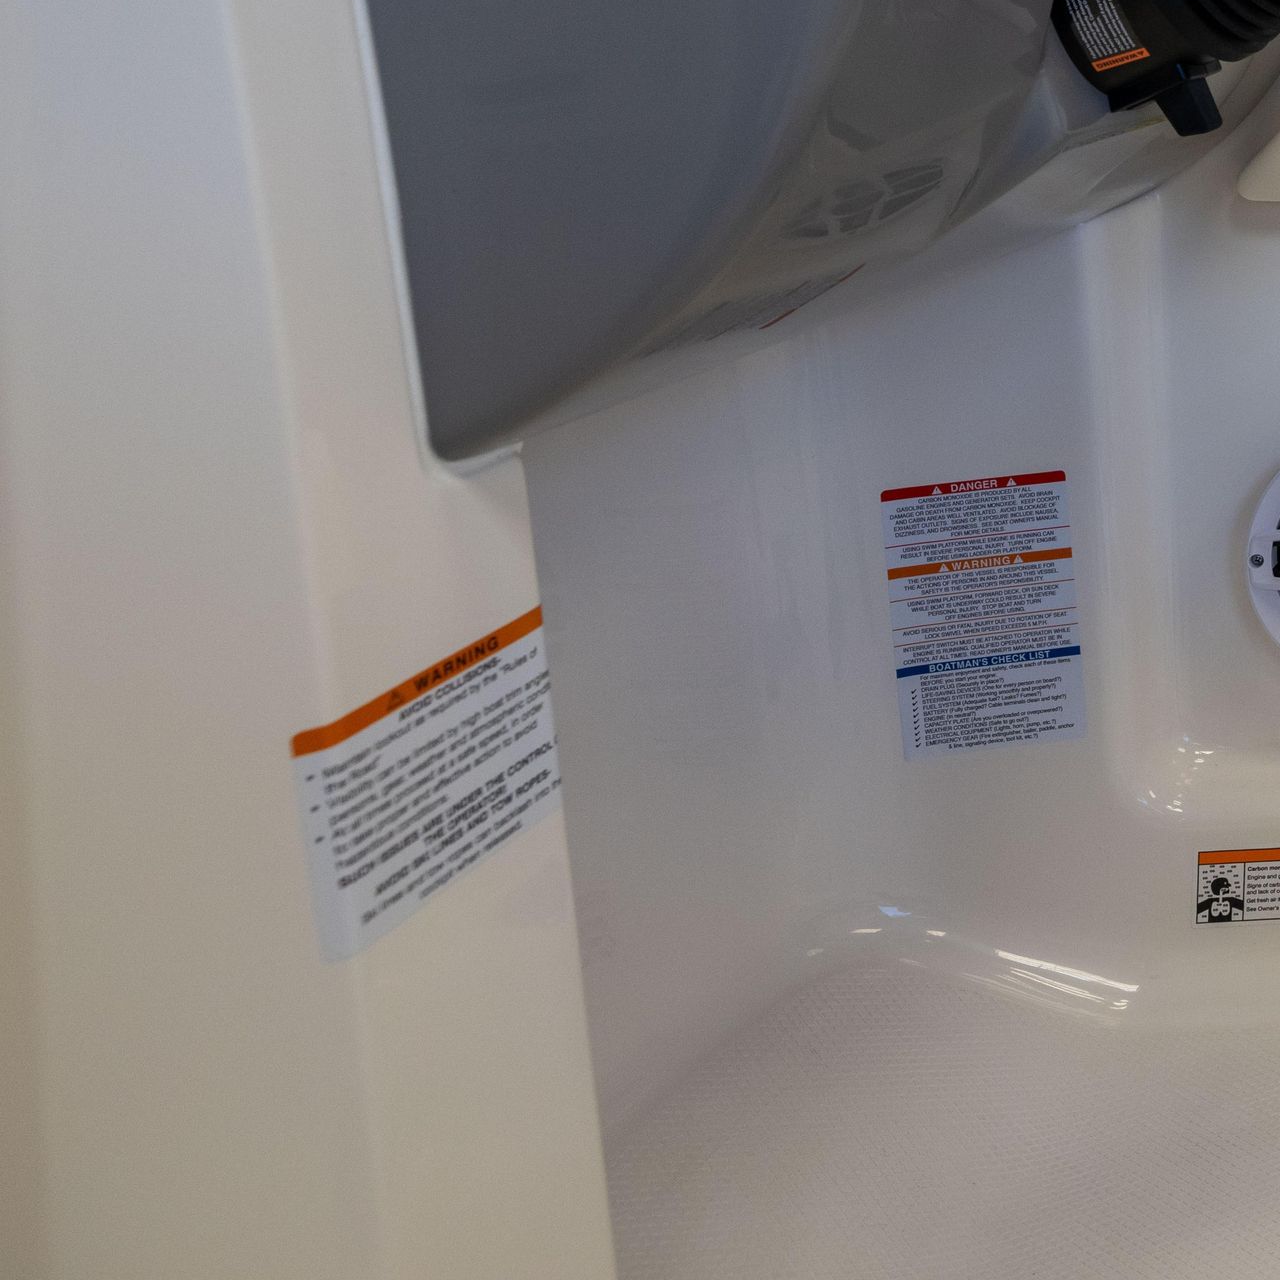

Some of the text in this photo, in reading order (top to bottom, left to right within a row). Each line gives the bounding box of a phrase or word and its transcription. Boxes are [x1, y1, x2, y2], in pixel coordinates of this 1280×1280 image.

[951, 480, 998, 492] DANGER
[918, 496, 942, 504] CARBON
[942, 492, 973, 501] MONOXIDE
[980, 488, 1012, 497] PRODUCED
[920, 574, 951, 583] OPERATOR
[974, 569, 995, 577] VESSEL
[1003, 564, 1041, 574] RESPONSIBLE
[951, 557, 1010, 571] WARNING
[414, 636, 499, 692] WARNING
[929, 651, 1051, 673] BOATMAN'S CHECK LIST
[507, 741, 554, 776] CONTROL
